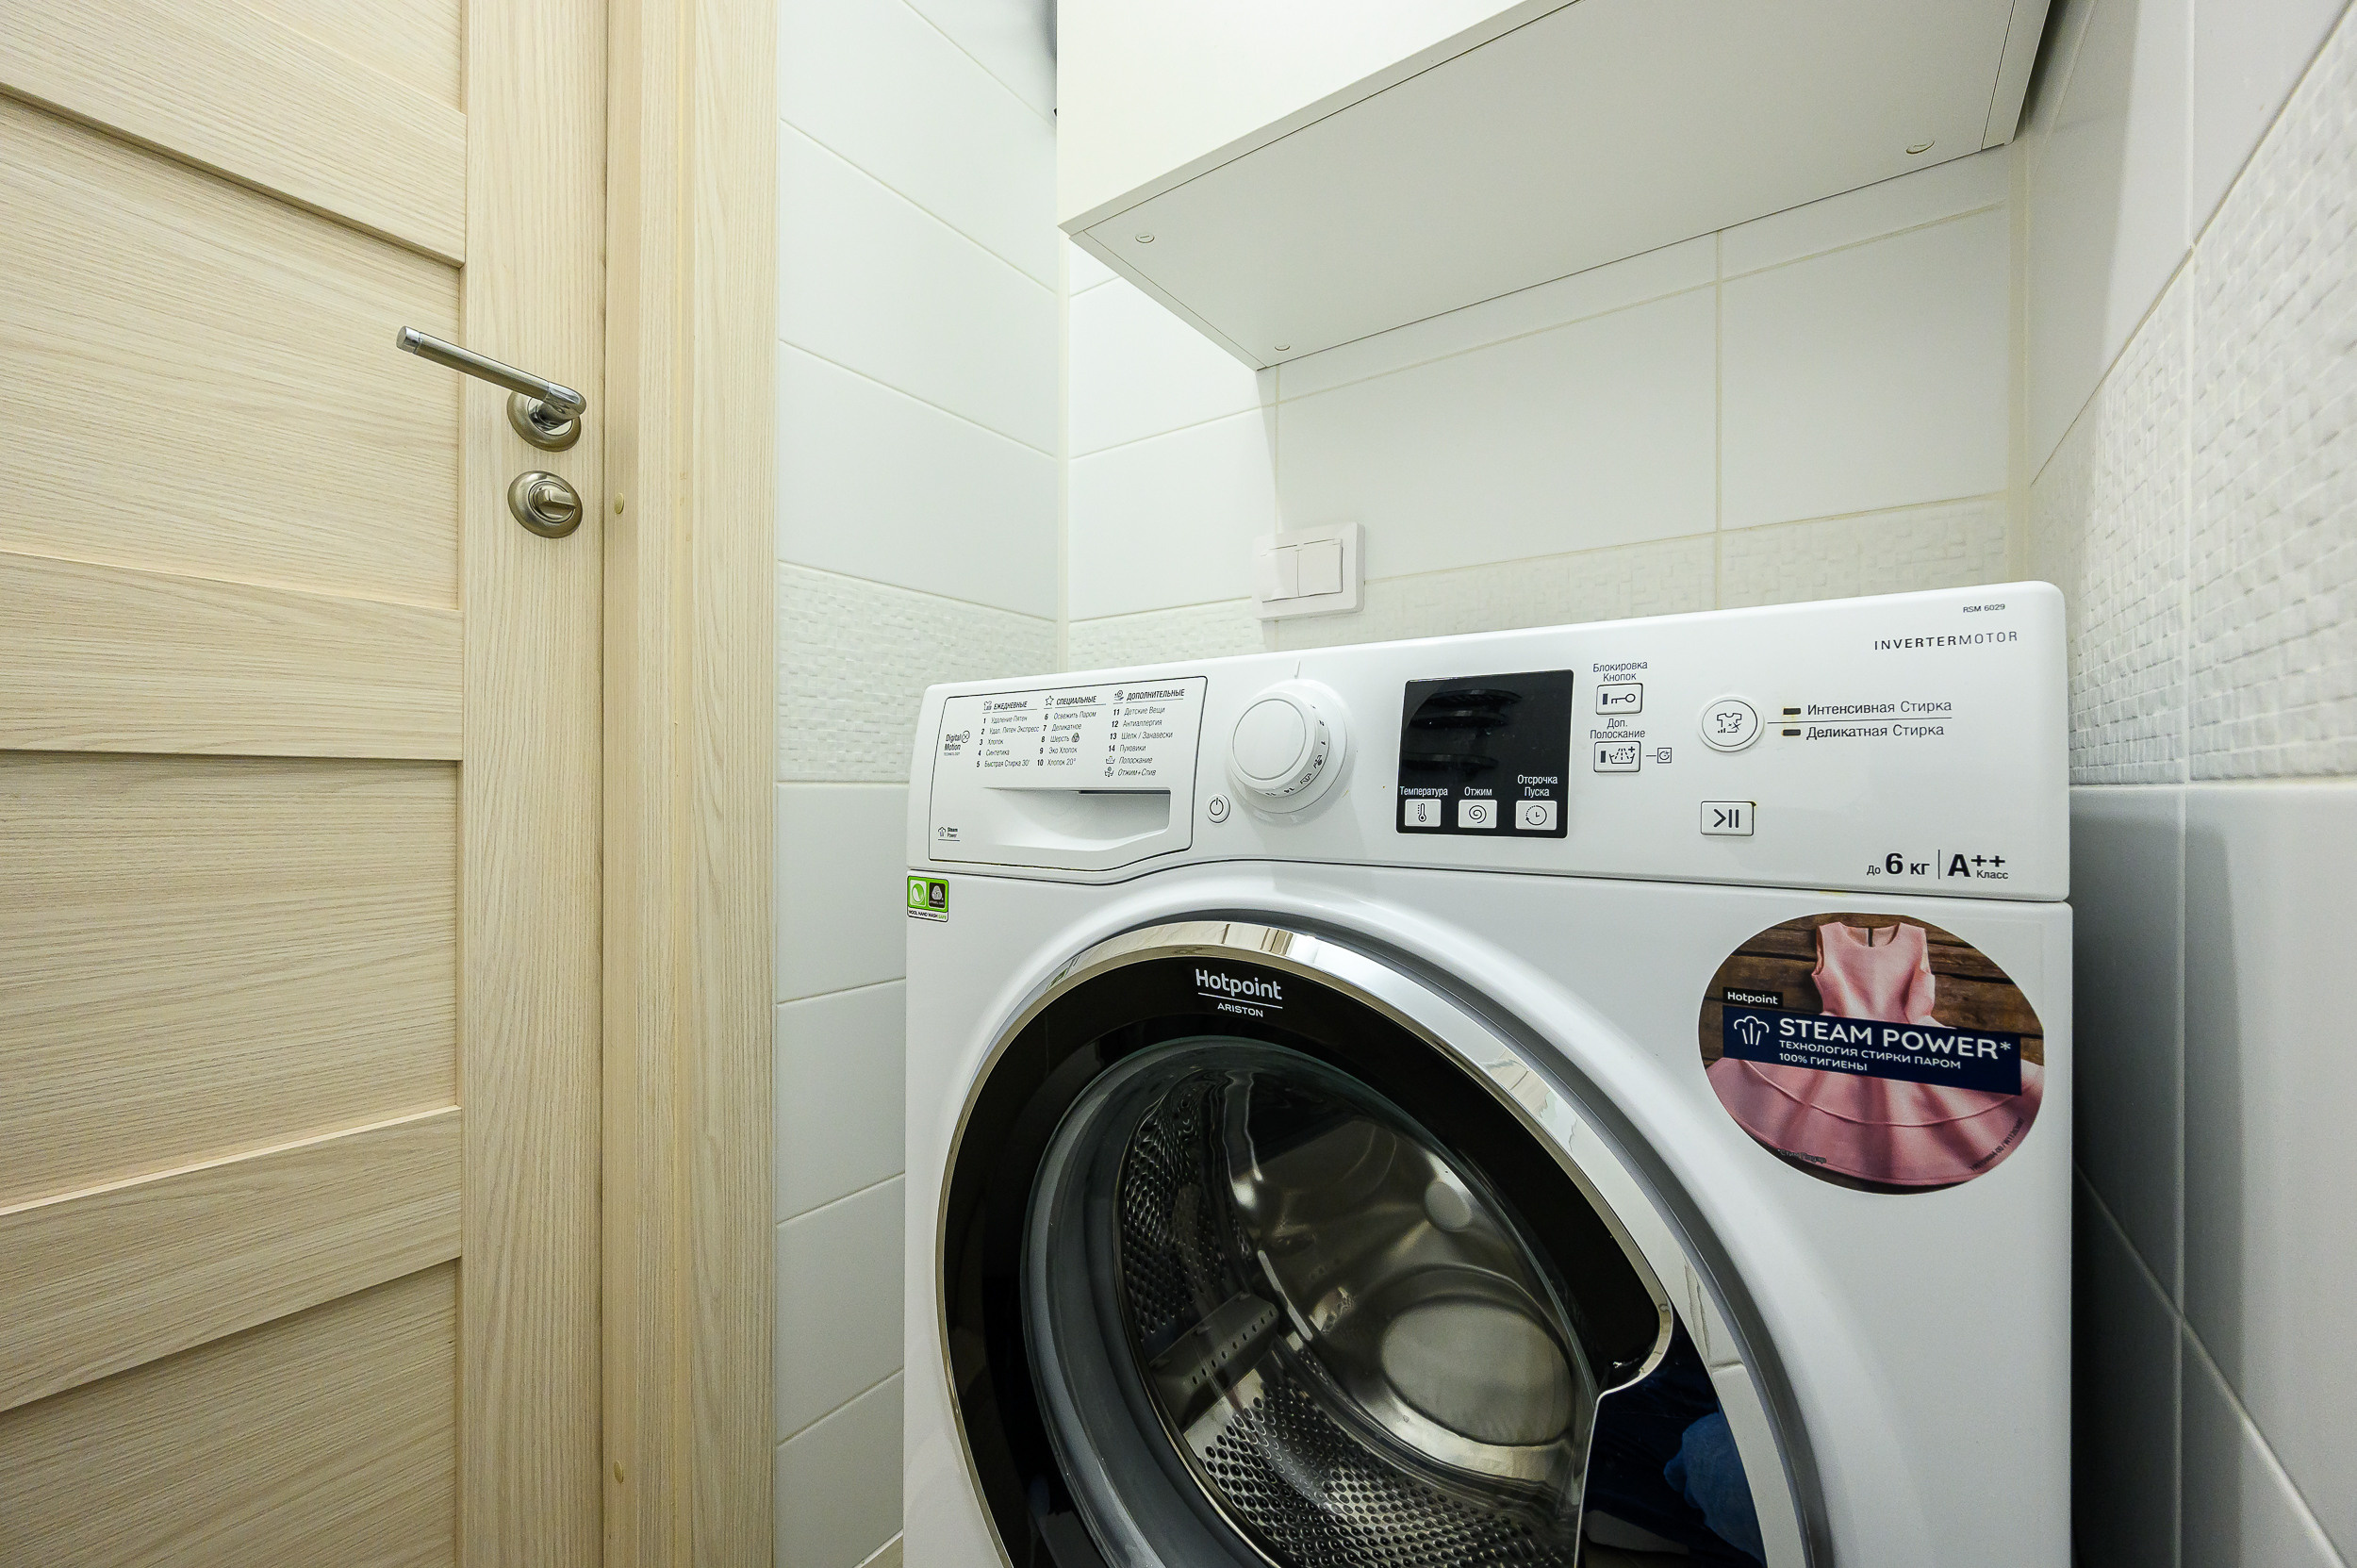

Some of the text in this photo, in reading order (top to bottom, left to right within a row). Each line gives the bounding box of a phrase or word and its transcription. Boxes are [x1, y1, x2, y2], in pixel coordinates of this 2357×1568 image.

[1962, 603, 2006, 613] RSM 6029
[1874, 631, 2019, 651] INVERTERMOTOR
[1592, 660, 1648, 673] Блокировка
[1603, 672, 1637, 683] Кнопок
[1056, 696, 1097, 705] СПЕЦИАЛЬНЫЕ
[1126, 689, 1185, 701] ДОПОЛНИТЕЛЬНЫЕ
[993, 701, 1029, 710] ЕЖЕДНЕВНЫЕ
[1124, 707, 1148, 717] Детские
[1148, 706, 1165, 715] Вещи
[1806, 700, 1953, 716] Интенсивная Стирка
[1080, 710, 1096, 719] Паром
[1051, 723, 1082, 732] Деликатное
[1607, 718, 1628, 730] Доп.
[1590, 729, 1646, 739] Полоскание
[1806, 724, 1945, 740] Деликатная Стирка
[946, 734, 962, 743] Digital
[944, 743, 961, 751] Motion
[1119, 744, 1146, 753] Пуховики
[1516, 774, 1558, 785] Отсрочка
[1399, 785, 1448, 797] Температура
[1463, 786, 1492, 797] Отжим
[1524, 786, 1550, 798] Пуска
[1866, 851, 1930, 877] До 6 кг
[1976, 868, 2009, 880] Класс
[1195, 968, 1282, 1000] Hotpoint
[1726, 991, 1778, 1005] Hotpoint
[1217, 1002, 1263, 1017] ARISTON
[1779, 1017, 1872, 1046] STEAM
[1779, 1040, 1961, 1069] ТЕХНОЛОГИЯ СТИРКИ ПАРОМ
[1778, 1052, 1868, 1071] 100% ГИГИЕНЫ
